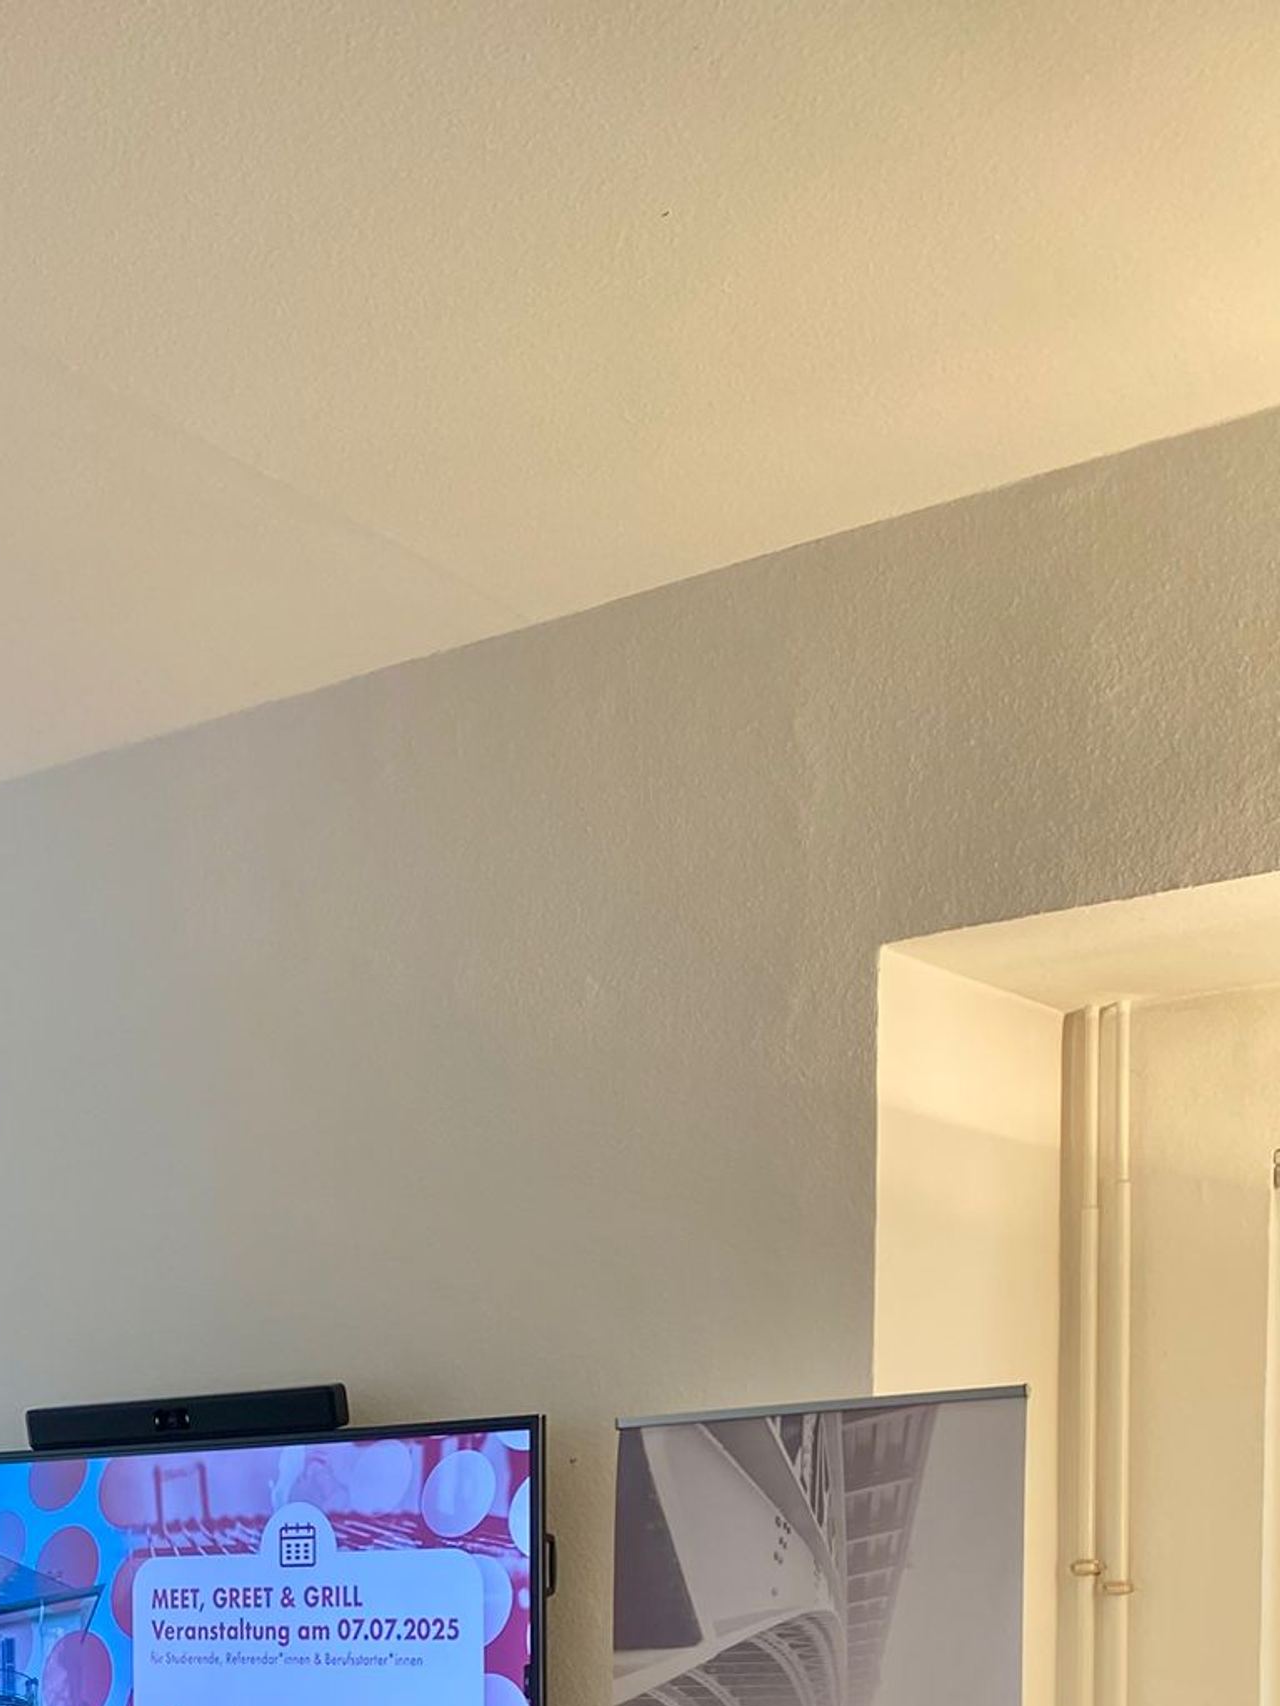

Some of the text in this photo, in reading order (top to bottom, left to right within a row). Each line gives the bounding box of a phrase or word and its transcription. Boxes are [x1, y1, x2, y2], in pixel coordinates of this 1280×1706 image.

[152, 1585, 363, 1612] MEET, GREET & GRILL
[151, 1617, 460, 1646] Veranstaltung am 07.07.2025
